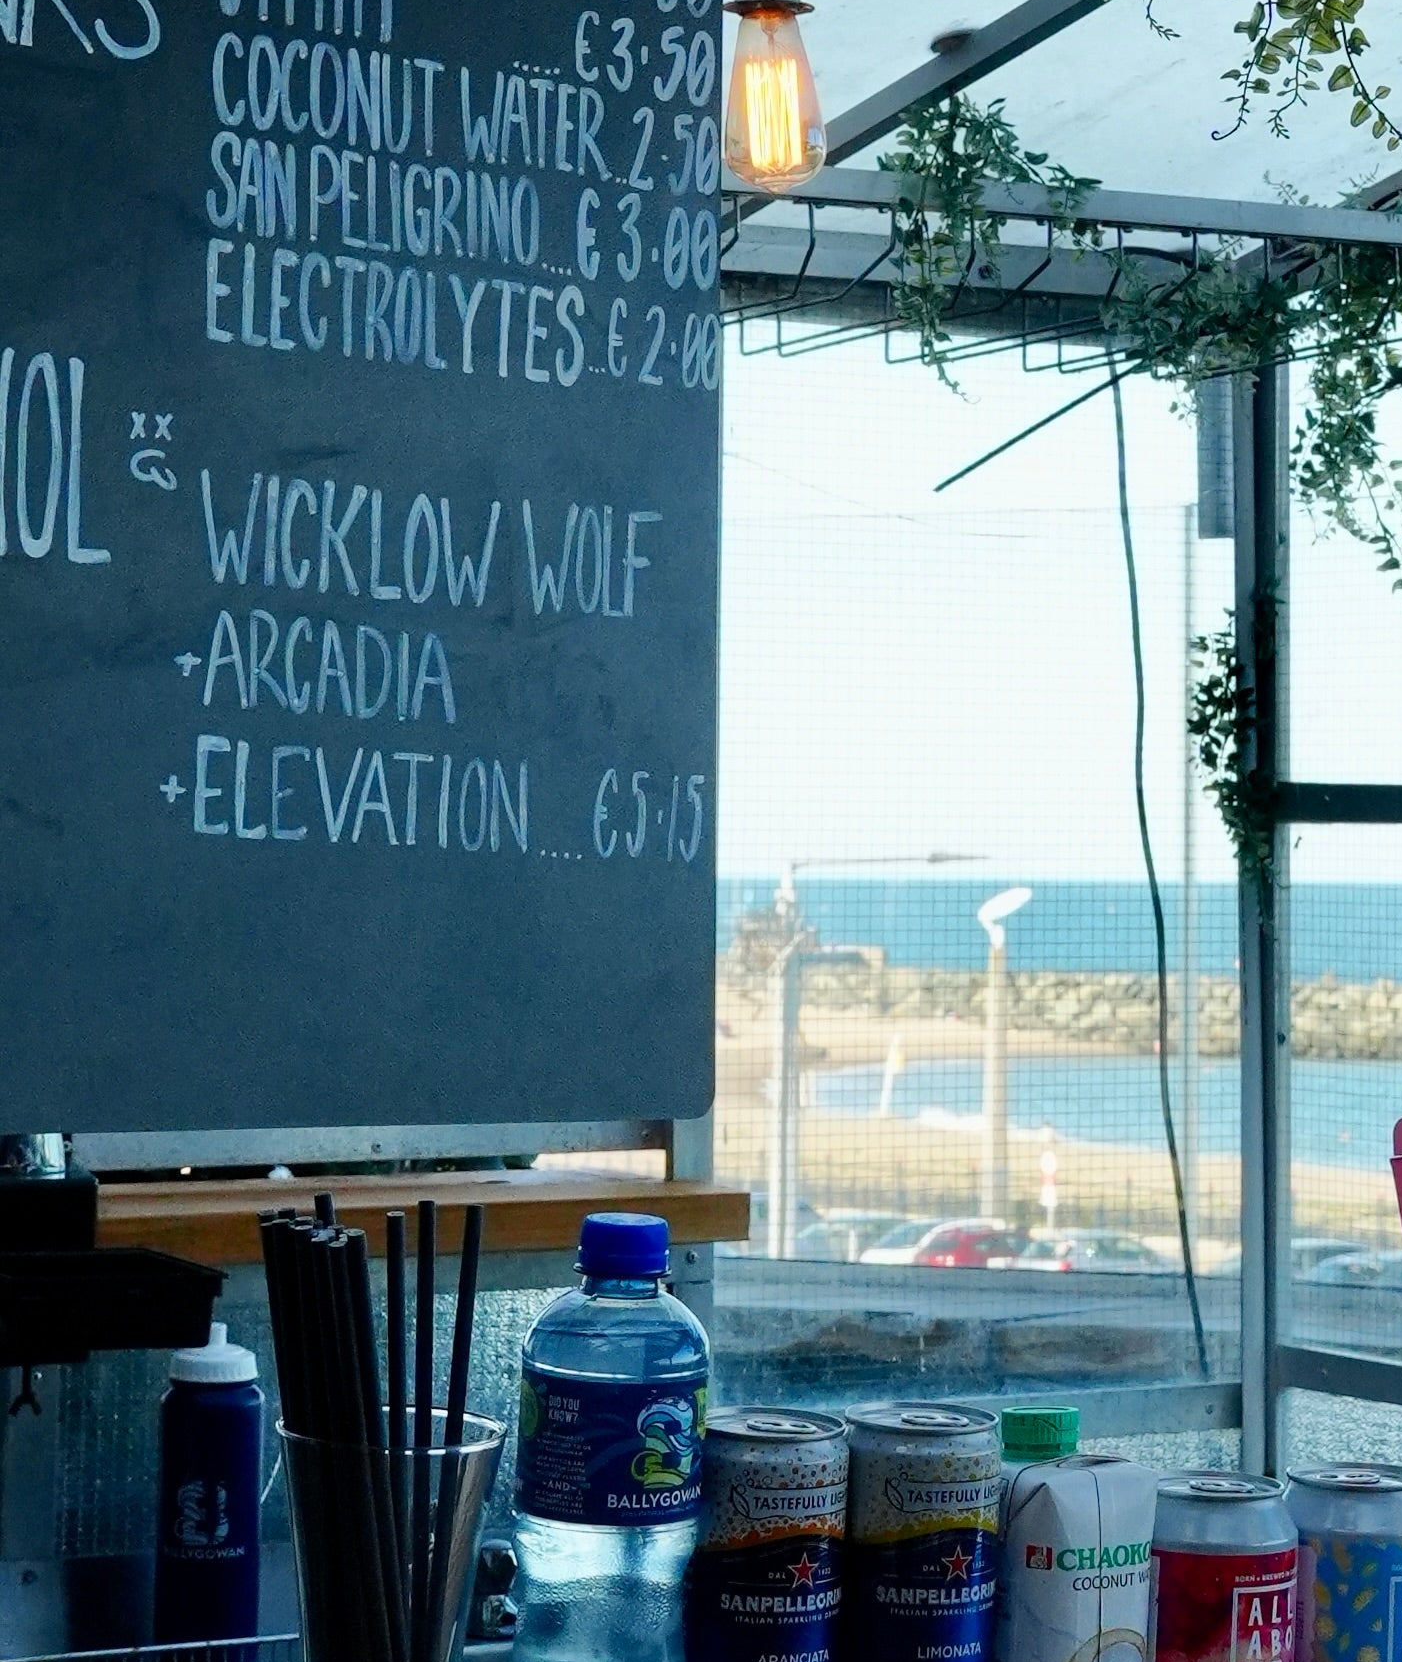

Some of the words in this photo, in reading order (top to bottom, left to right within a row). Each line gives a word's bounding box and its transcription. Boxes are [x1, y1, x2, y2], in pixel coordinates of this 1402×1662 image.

[213, 32, 445, 156] COCONUT
[207, 131, 297, 240] SAN
[202, 469, 501, 608] WICKLOW
[523, 499, 663, 618] WOLF
[563, 1396, 580, 1411] YOU
[607, 1483, 702, 1509] BALLYGOWAN
[753, 1495, 828, 1510] TASTEFULLY
[908, 1487, 980, 1503] TASTEFULLY
[1072, 1572, 1135, 1591] COCONUT
[1248, 1592, 1294, 1626] ALL
[917, 1641, 982, 1659] LIMONATA
